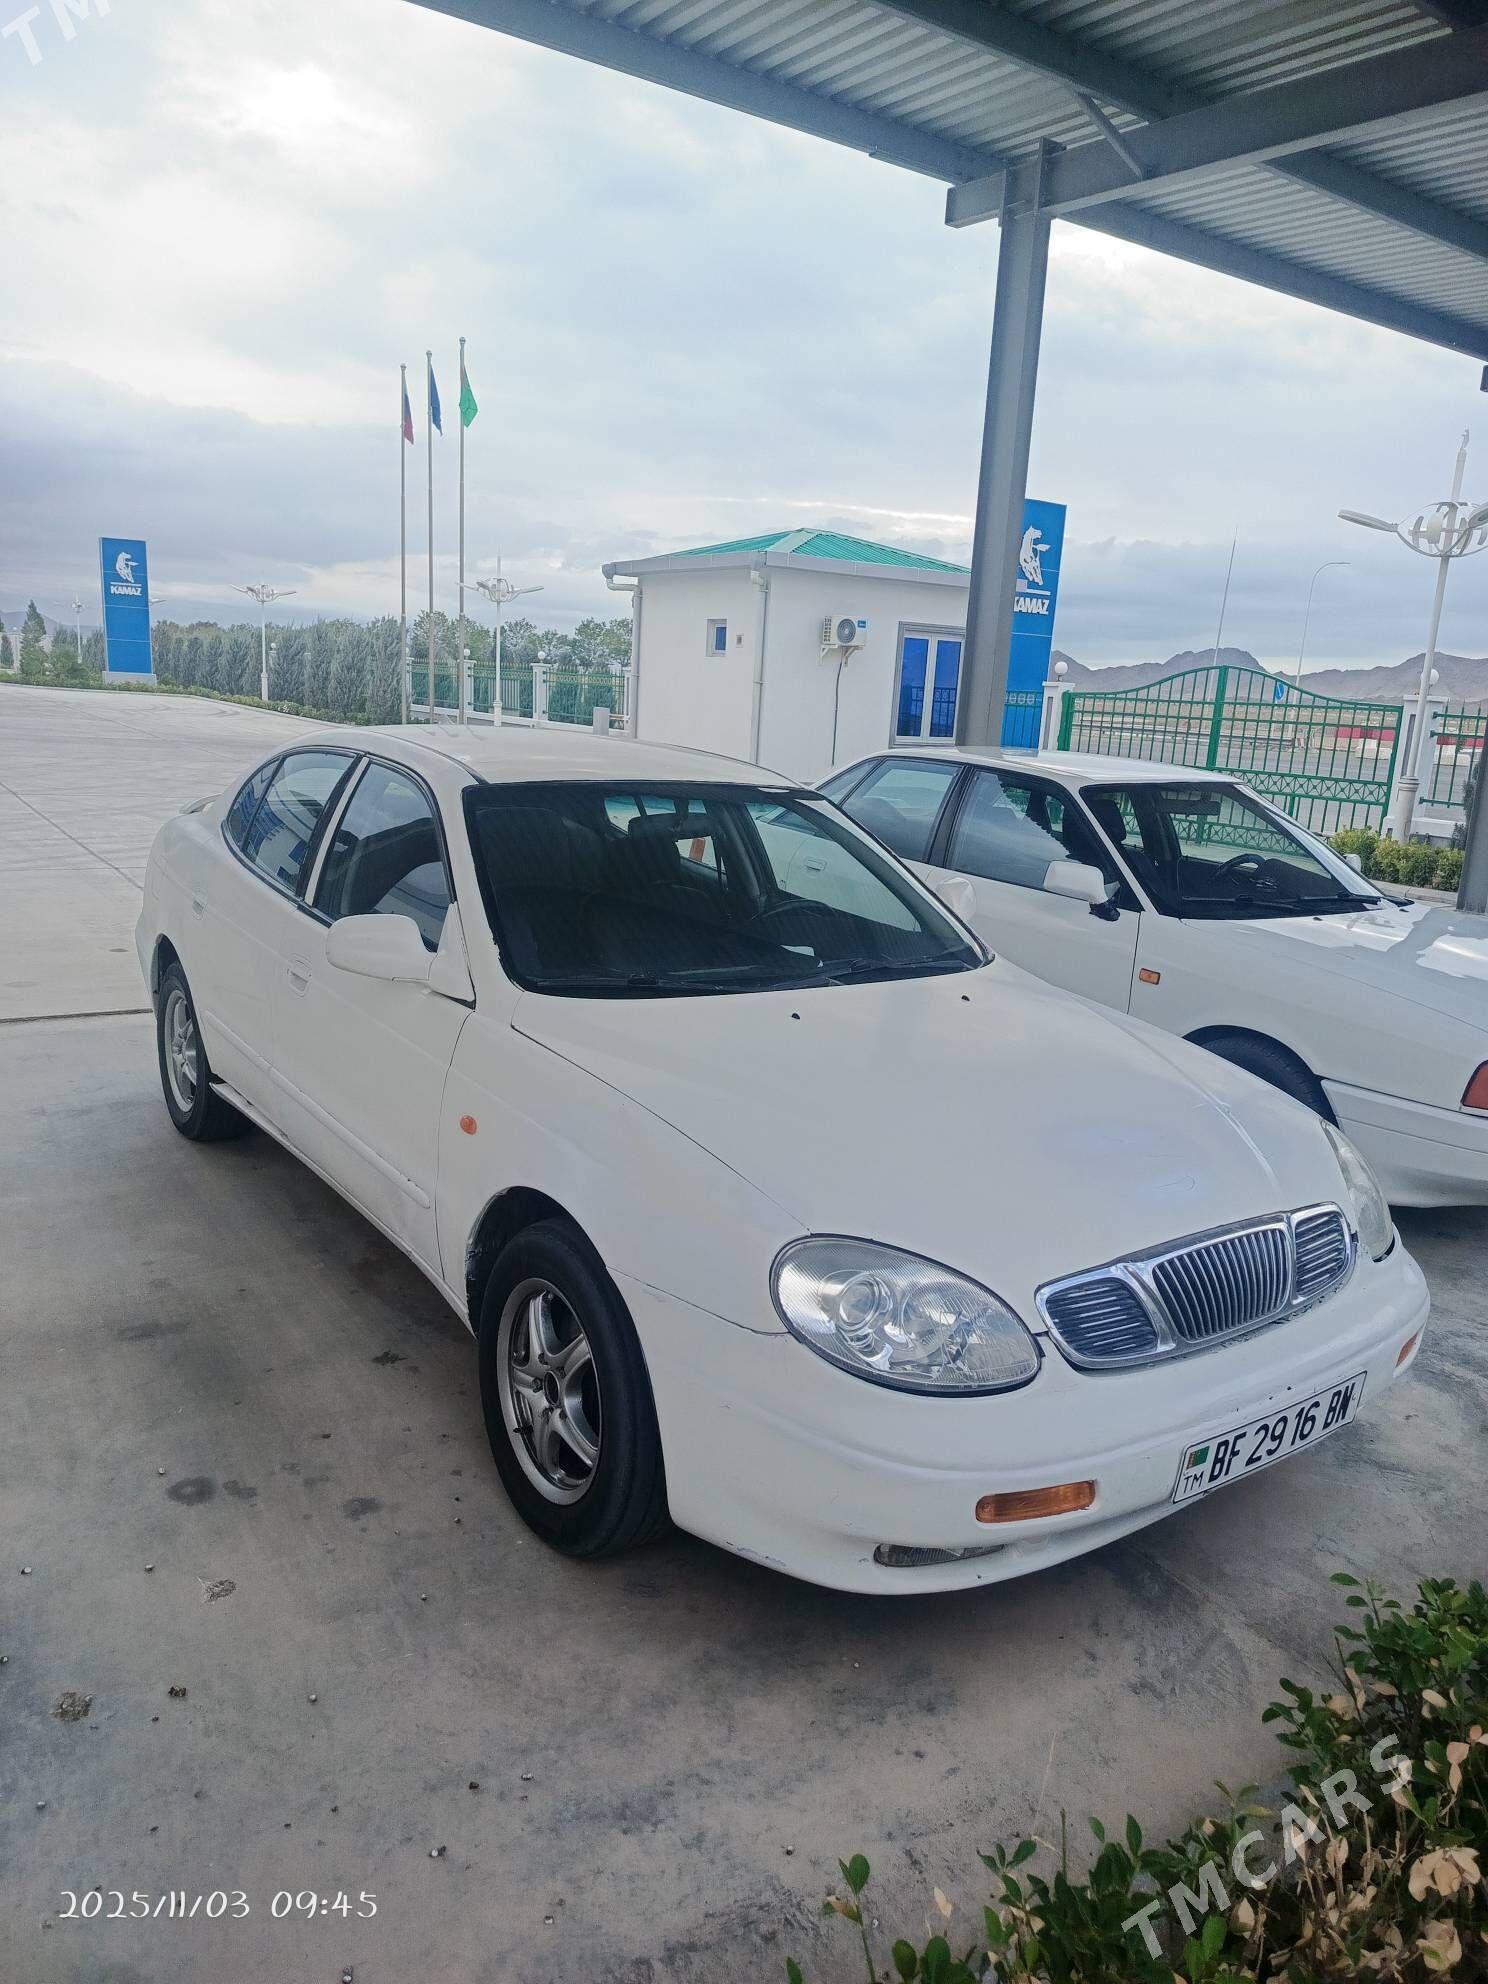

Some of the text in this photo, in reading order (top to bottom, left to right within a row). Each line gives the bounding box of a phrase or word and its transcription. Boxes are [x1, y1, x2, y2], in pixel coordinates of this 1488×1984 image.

[111, 586, 142, 596] KAMAZ
[1208, 1432, 1246, 1483] BF
[1323, 1383, 1355, 1430] BN
[1184, 1471, 1204, 1493] TM
